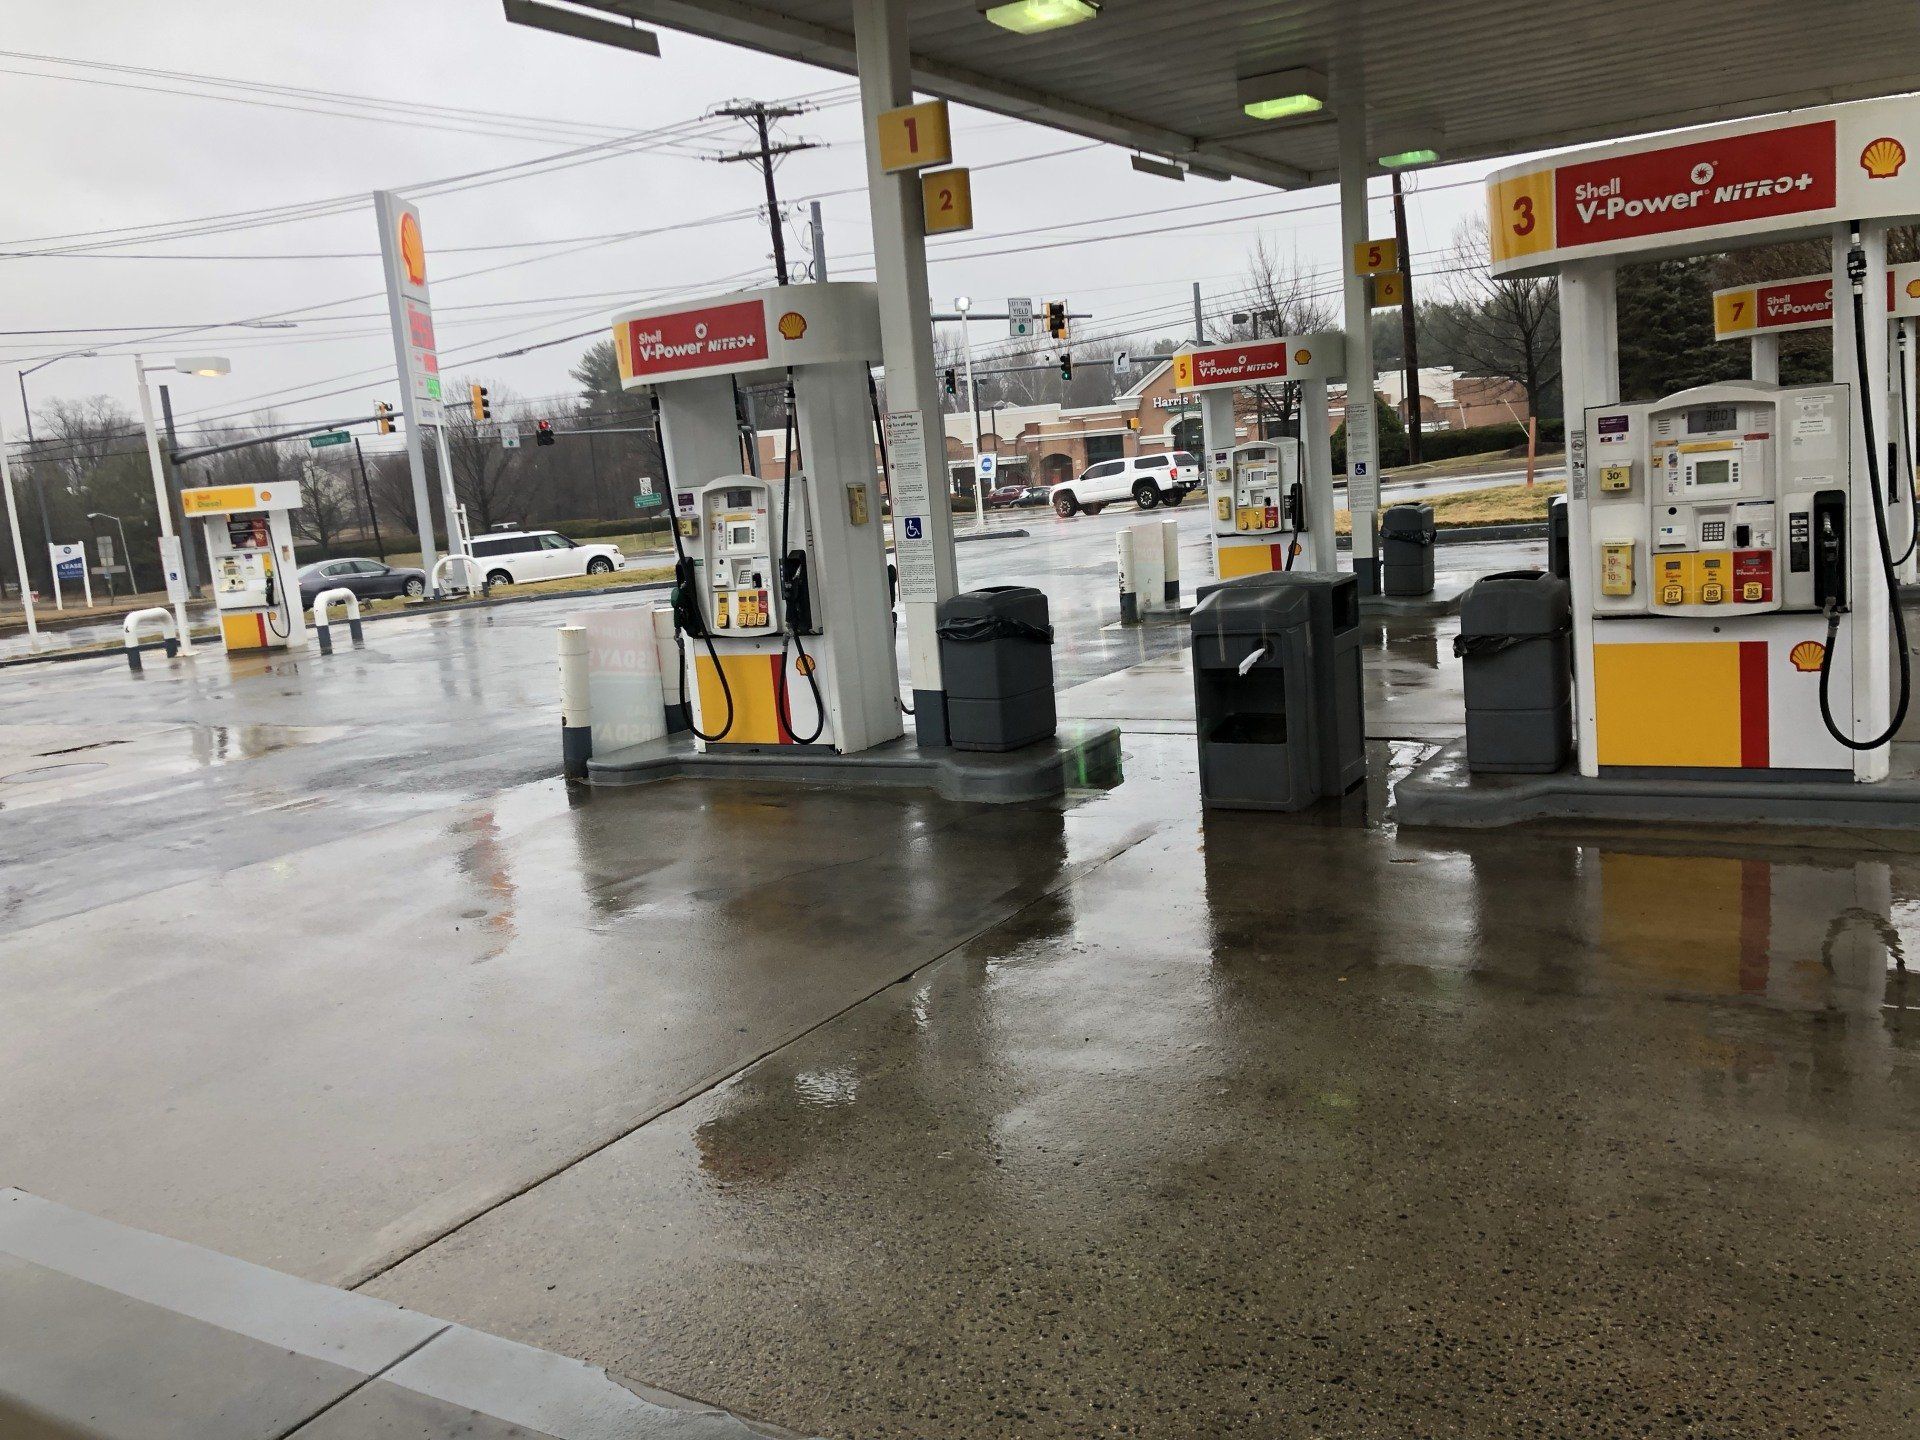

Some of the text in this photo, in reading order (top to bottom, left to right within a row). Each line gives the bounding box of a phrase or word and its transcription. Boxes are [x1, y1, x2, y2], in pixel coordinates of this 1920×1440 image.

[904, 117, 919, 154] 1
[1575, 177, 1621, 200] Shell
[939, 188, 954, 212] 2
[1576, 190, 1704, 224] V-Power
[1513, 195, 1536, 236] 3
[1368, 245, 1382, 267] 5
[1384, 281, 1394, 295] 6
[1767, 294, 1791, 306] Shell
[1732, 301, 1745, 322] 7
[1767, 301, 1833, 318] V-Power
[638, 329, 662, 345] Shell
[640, 341, 703, 362] V-Power
[1179, 362, 1187, 380] 5
[1198, 358, 1216, 368] Shell
[1199, 365, 1244, 378] V-Power
[1152, 395, 1189, 408] Harris
[1667, 590, 1678, 598] 87
[1706, 589, 1718, 597] 89
[1746, 587, 1759, 595] 93
